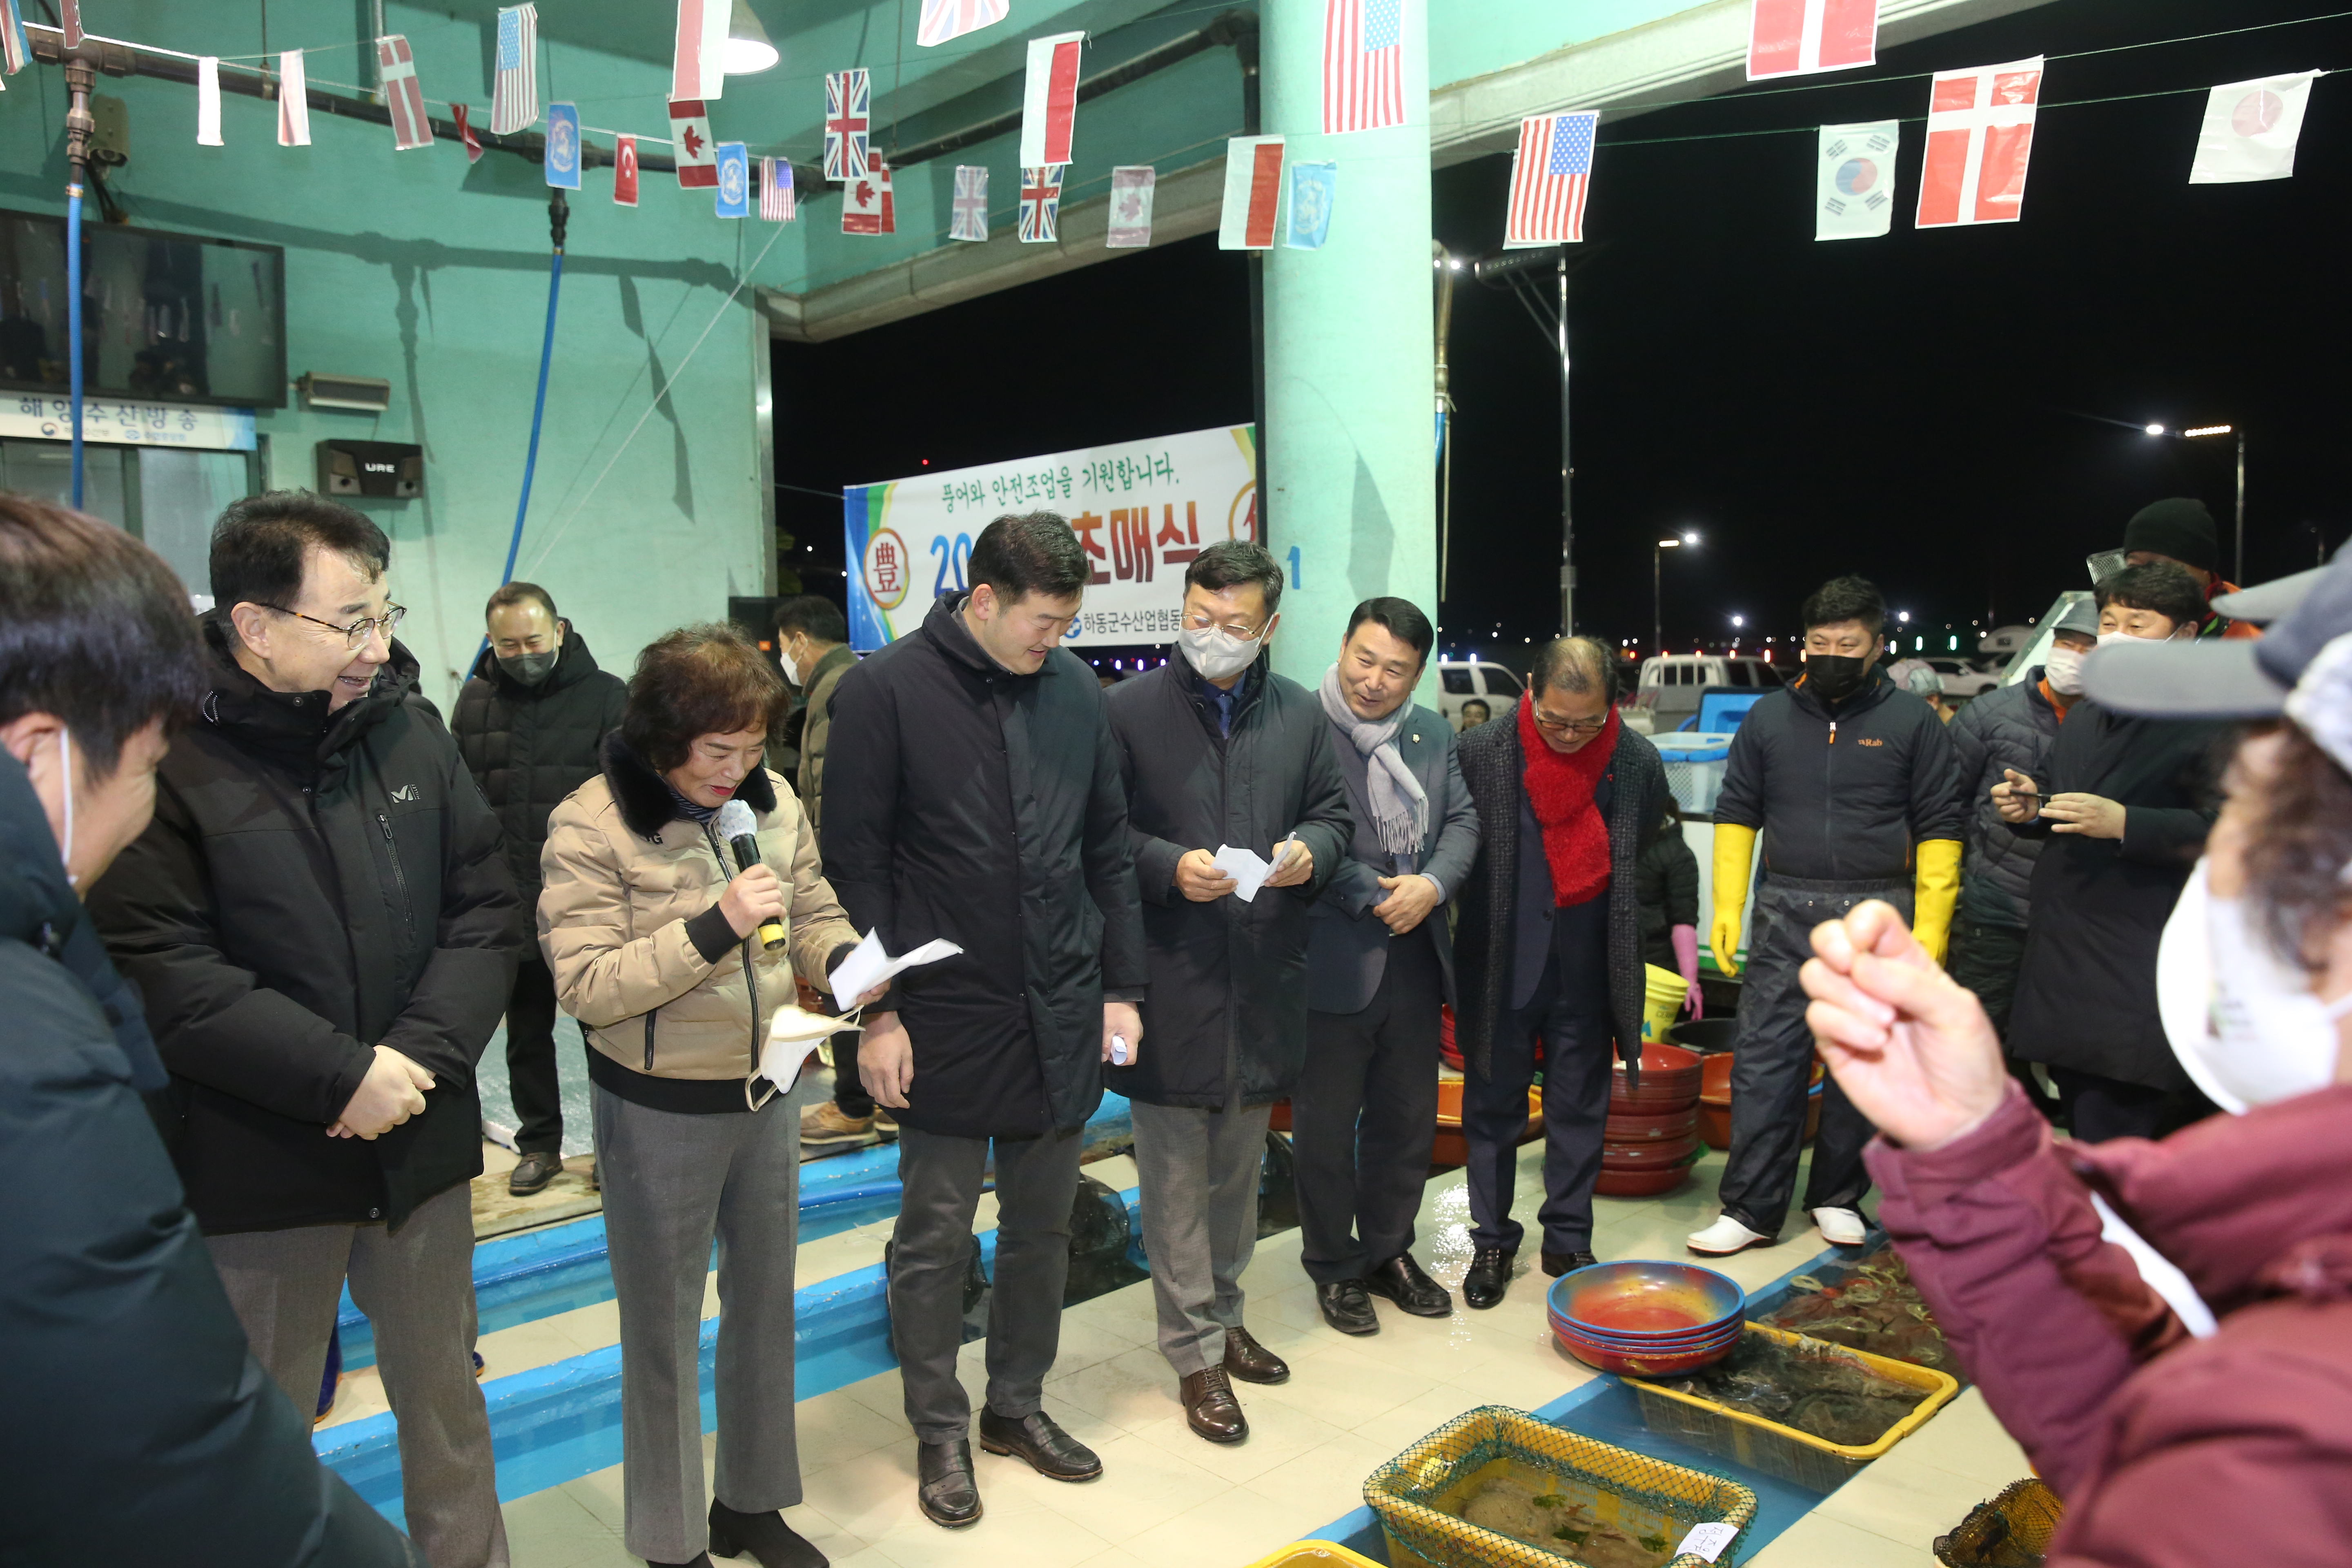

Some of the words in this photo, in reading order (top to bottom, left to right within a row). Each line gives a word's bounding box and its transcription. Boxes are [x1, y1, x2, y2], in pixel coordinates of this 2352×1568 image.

[942, 479, 985, 513] 풍어와
[992, 466, 1073, 506] 안전조업을
[1082, 451, 1179, 494] 기원합니다.
[1071, 501, 1200, 585] 초매식
[1287, 546, 1300, 589] 1
[1865, 738, 1883, 747] Rab
[411, 784, 421, 800] MILLET
